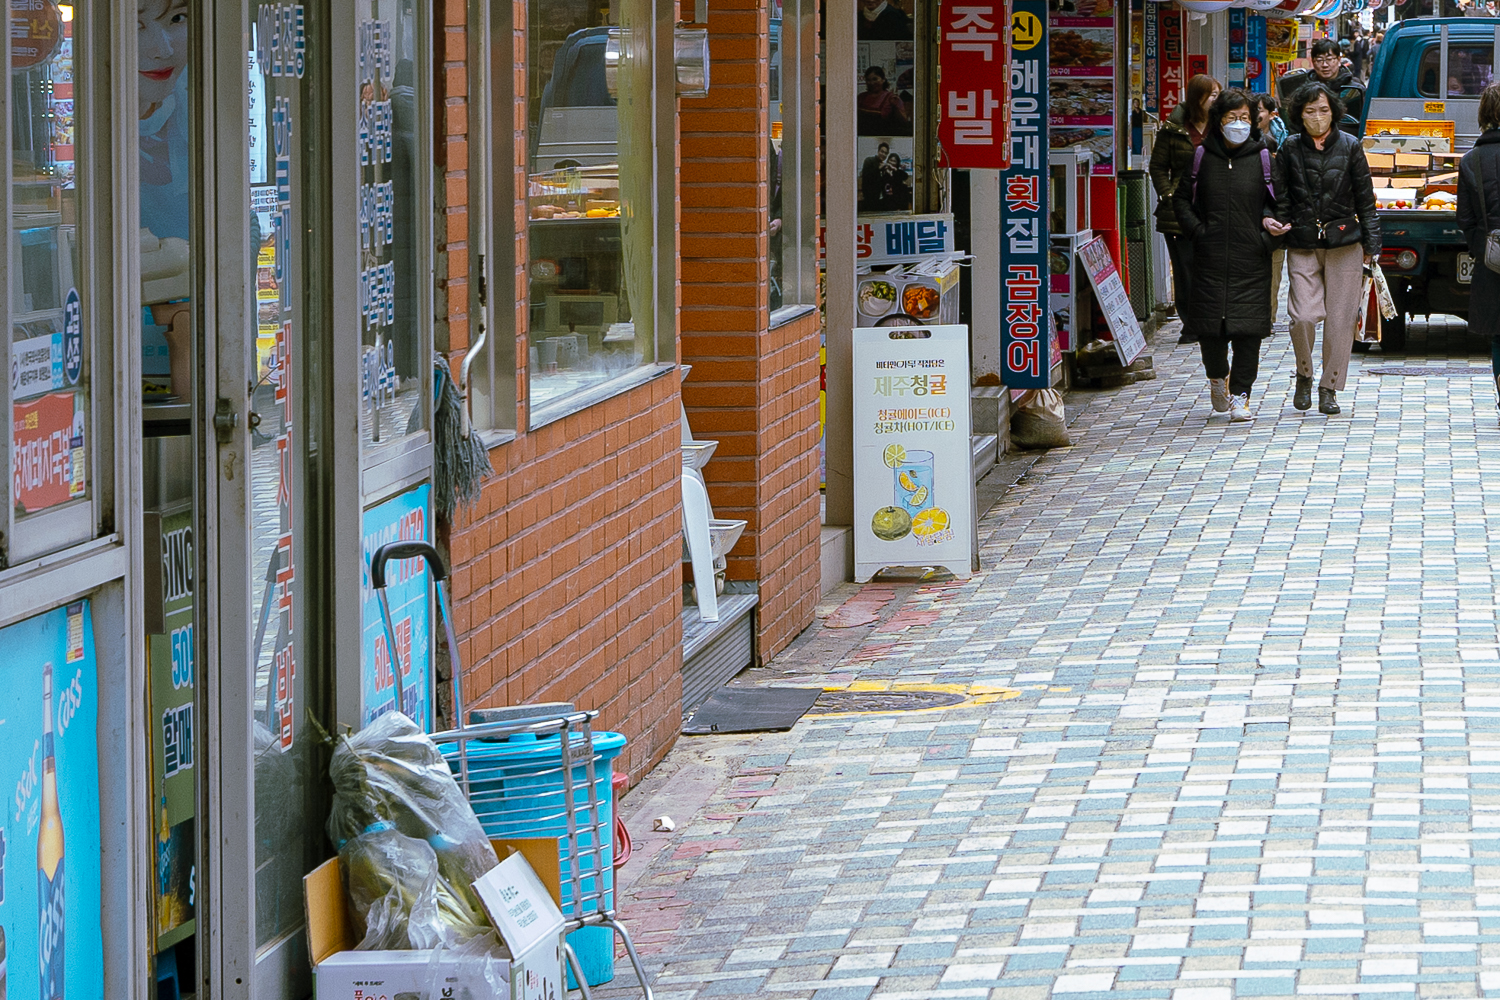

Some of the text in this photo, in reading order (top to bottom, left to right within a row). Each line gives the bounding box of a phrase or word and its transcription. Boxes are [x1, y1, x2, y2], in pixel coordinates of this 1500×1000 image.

[946, 5, 999, 145] 족발
[1011, 58, 1040, 171] 해운대
[886, 220, 948, 256] 배달
[1005, 176, 1039, 255] 횟집
[1005, 264, 1042, 378] 곰장어
[873, 374, 947, 397] 제주청귤
[171, 622, 193, 690] 50
[58, 668, 82, 737] Cass
[162, 702, 193, 779] 할매
